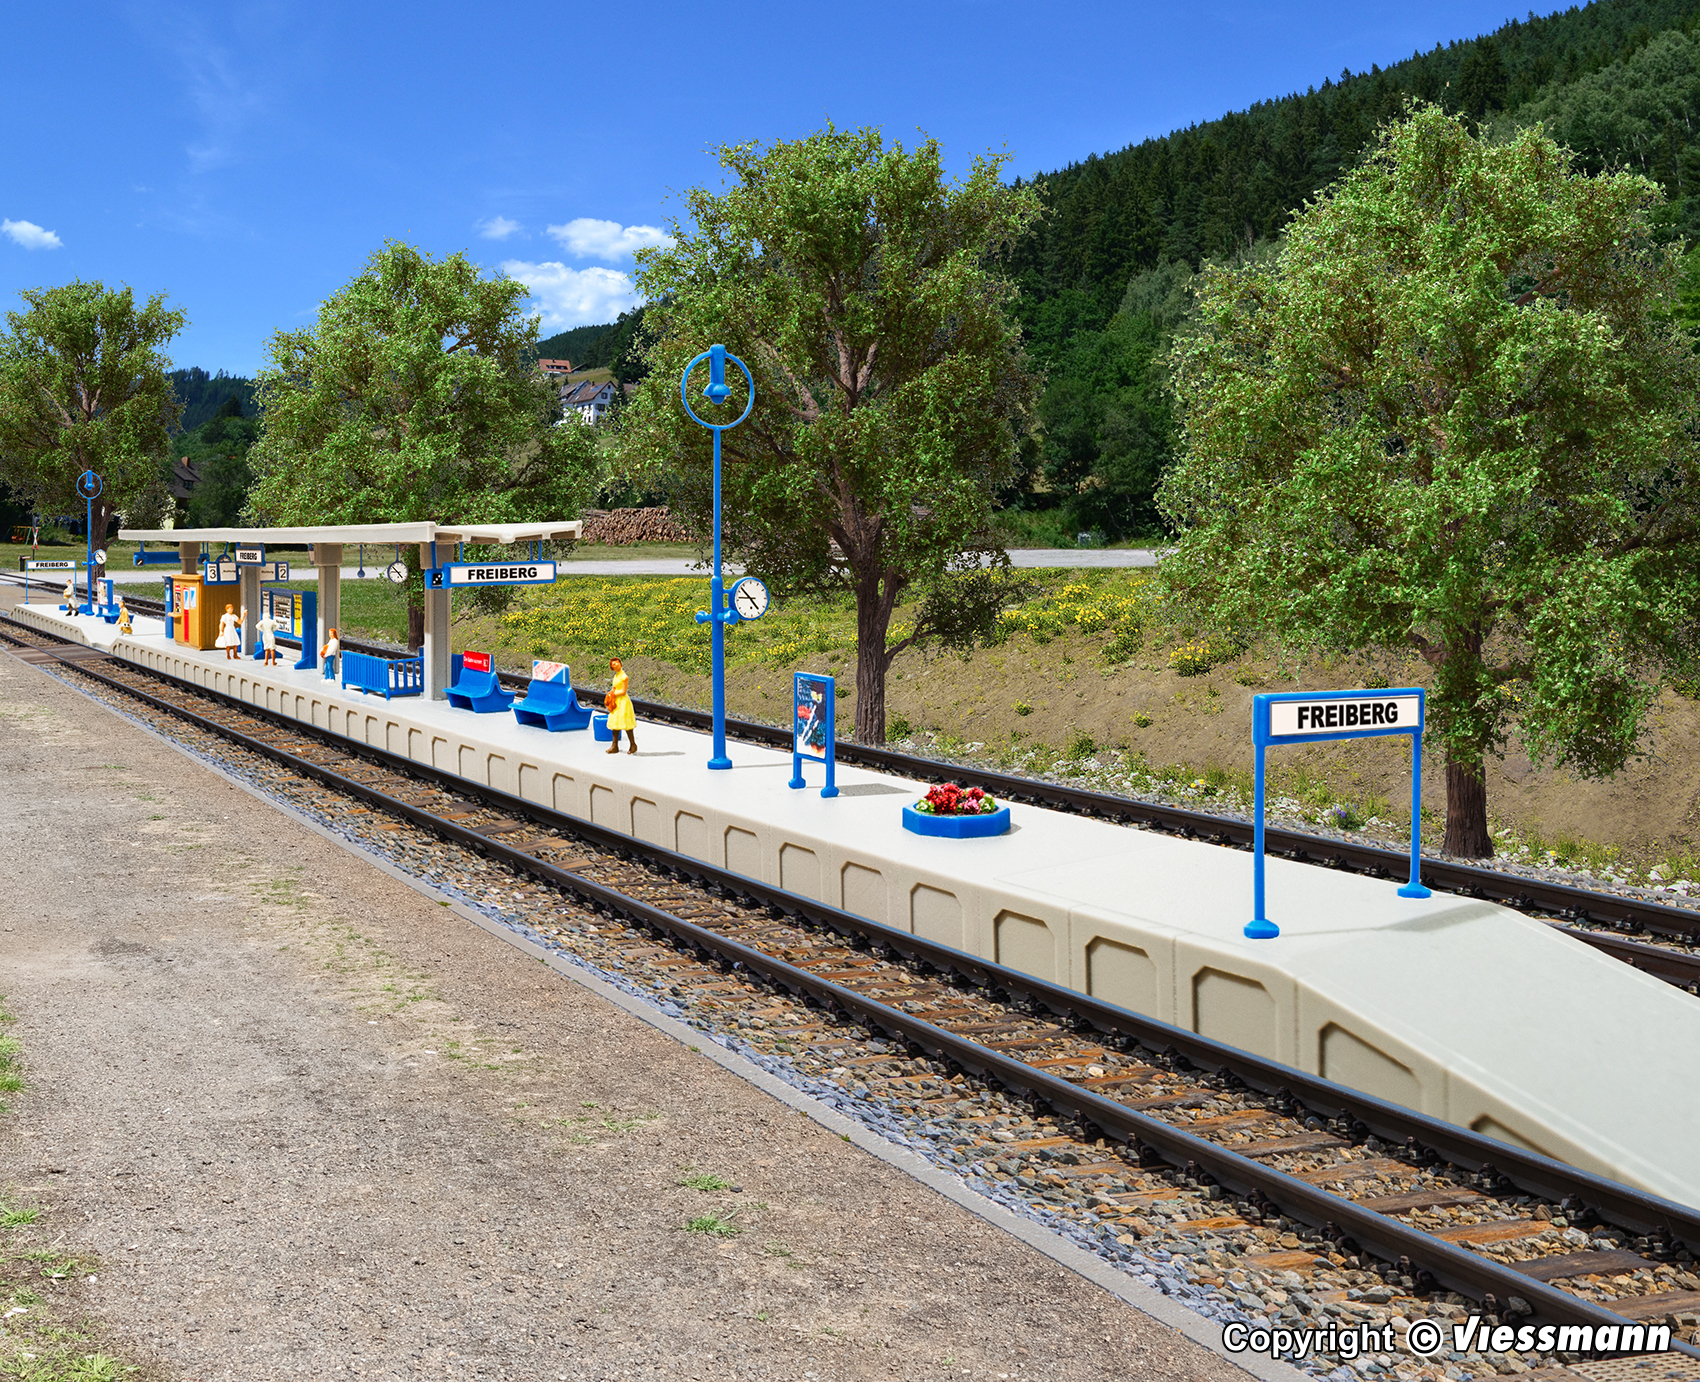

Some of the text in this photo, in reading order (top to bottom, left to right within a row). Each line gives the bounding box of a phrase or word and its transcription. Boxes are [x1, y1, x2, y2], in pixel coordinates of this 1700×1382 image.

[240, 552, 257, 560] FREIBERG
[209, 569, 217, 579] 3
[280, 569, 287, 579] 2
[468, 567, 538, 580] FREIBERG
[1297, 702, 1399, 729] FREIBERG
